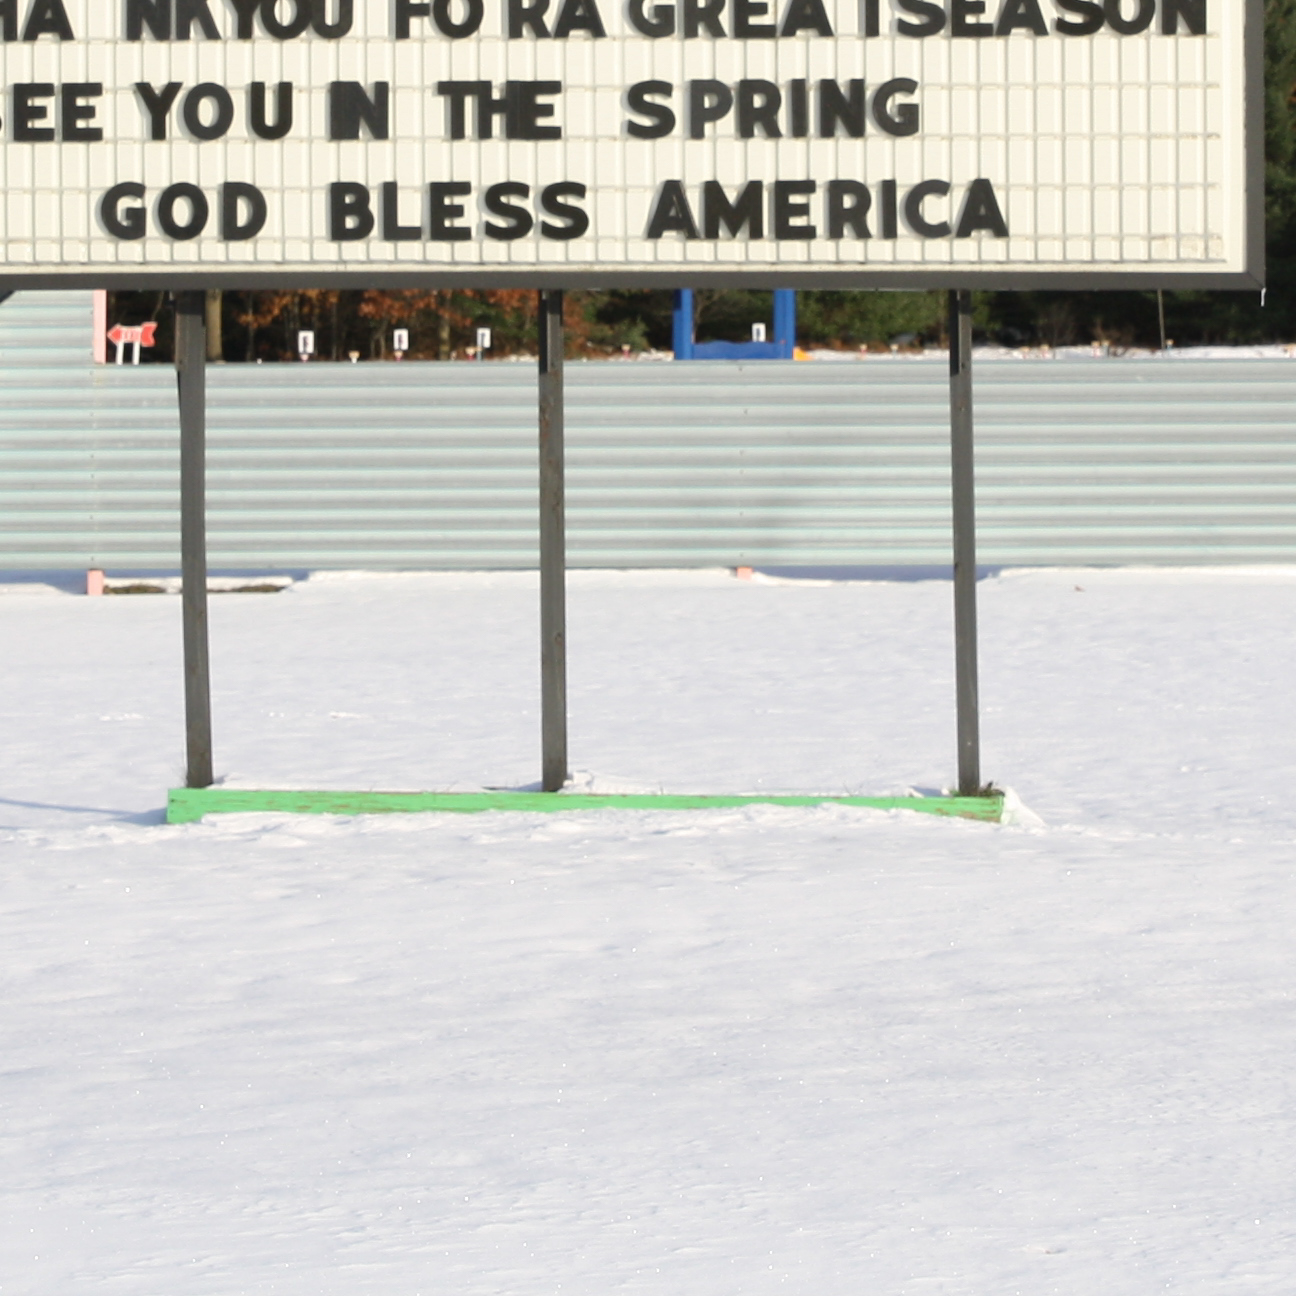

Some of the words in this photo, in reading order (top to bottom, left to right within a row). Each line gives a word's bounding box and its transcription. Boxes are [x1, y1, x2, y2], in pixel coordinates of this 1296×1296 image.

[135, 81, 293, 141] YOU
[437, 80, 562, 141] THE
[627, 77, 919, 140] SPRING
[100, 182, 267, 241] GOD
[330, 181, 589, 241] BLESS
[647, 178, 1009, 240] AMERICA
